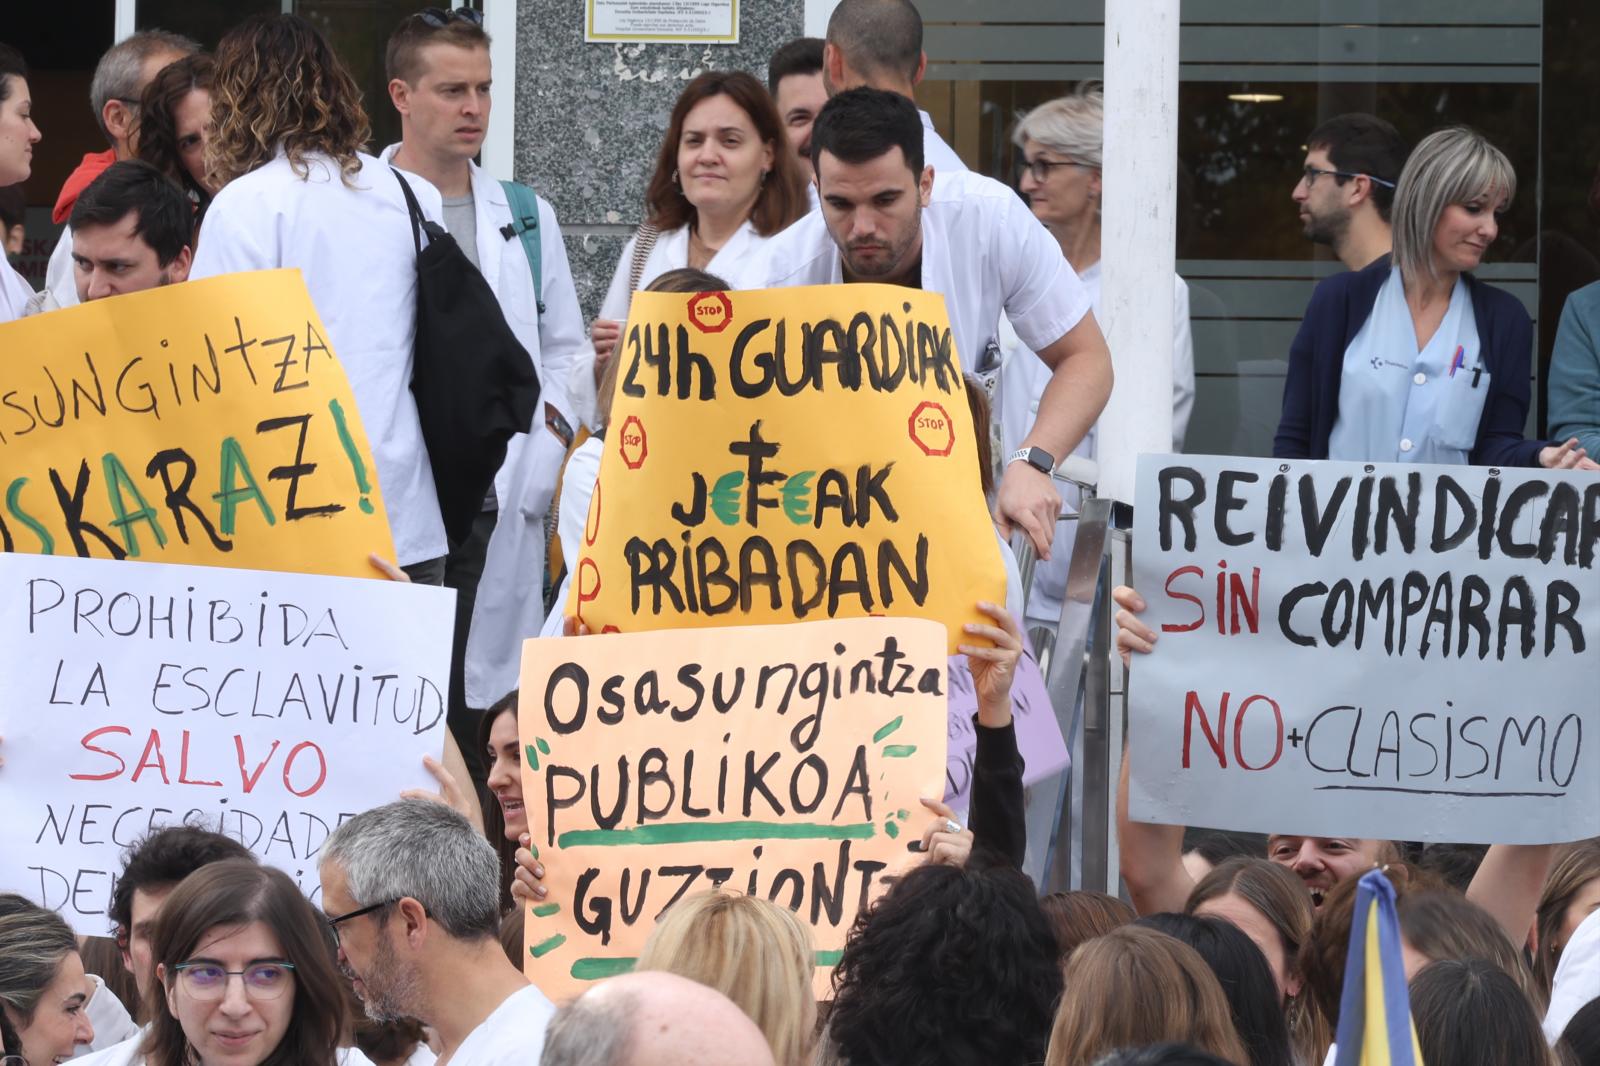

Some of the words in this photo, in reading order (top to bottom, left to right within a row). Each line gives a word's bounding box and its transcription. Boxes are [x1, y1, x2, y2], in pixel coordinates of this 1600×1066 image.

[696, 305, 723, 316] STOP
[622, 322, 717, 401] 24h
[624, 434, 641, 446] STOP
[918, 417, 945, 430] STOP
[0, 398, 374, 561] SKARAZ!
[1278, 570, 1586, 661] COMPARAR
[49, 659, 110, 707] LA
[544, 636, 943, 753] Osasungintza
[68, 725, 327, 797] SALVO
